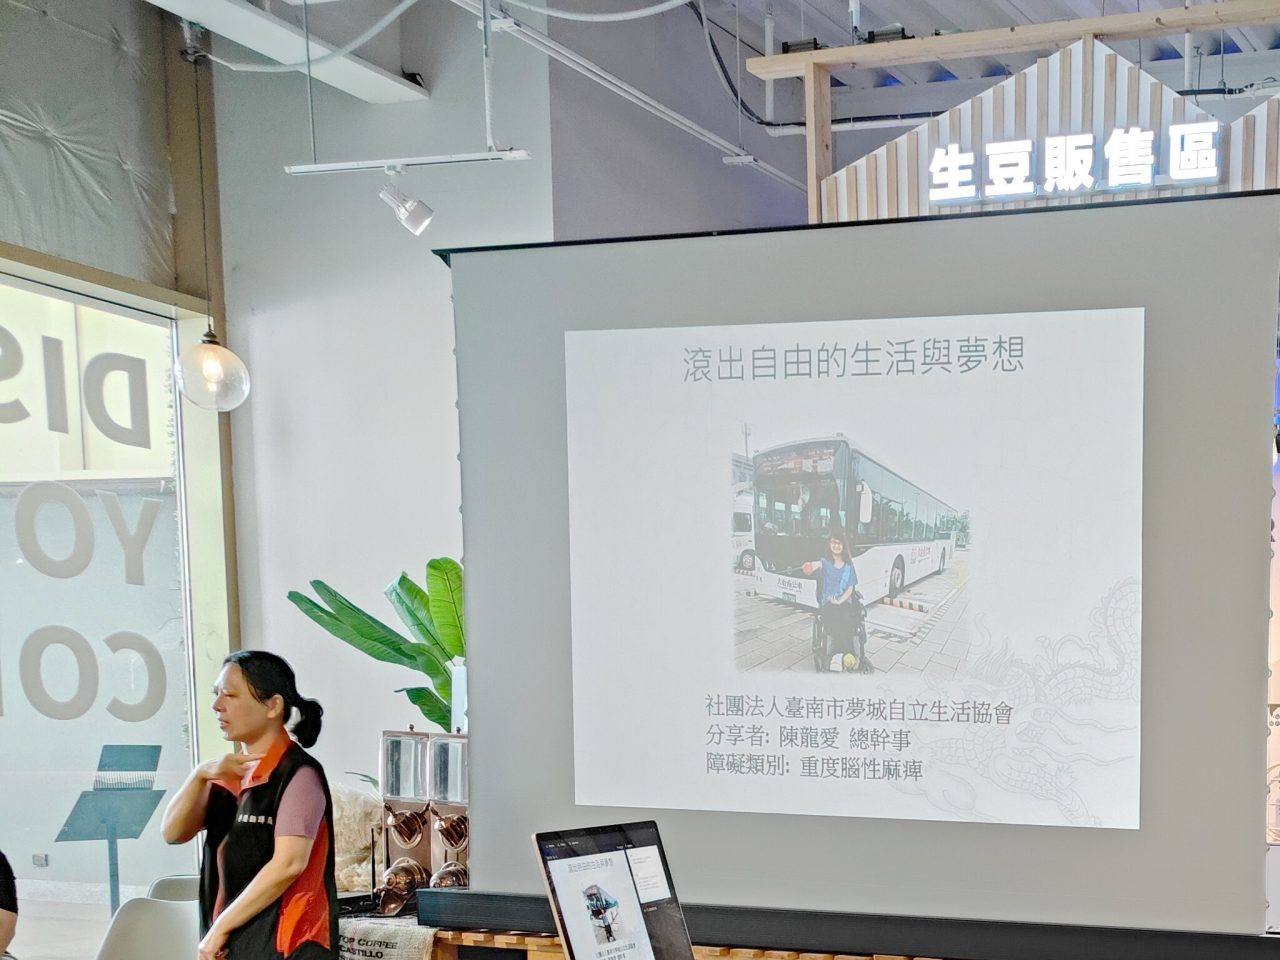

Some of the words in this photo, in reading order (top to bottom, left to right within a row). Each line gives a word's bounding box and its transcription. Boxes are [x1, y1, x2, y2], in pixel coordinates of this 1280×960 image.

[929, 121, 1219, 200] 生豆販售區
[683, 335, 1025, 383] 滾出自由的生活與夢想
[705, 694, 1014, 725] 社團法人臺南市夢城自立生活協會
[706, 724, 769, 747] 分享者:
[779, 726, 840, 750] 陳龍愛
[849, 728, 912, 752] 總幹事
[706, 752, 790, 776] 障礙類別:
[799, 755, 923, 782] 重度腦性麻痺
